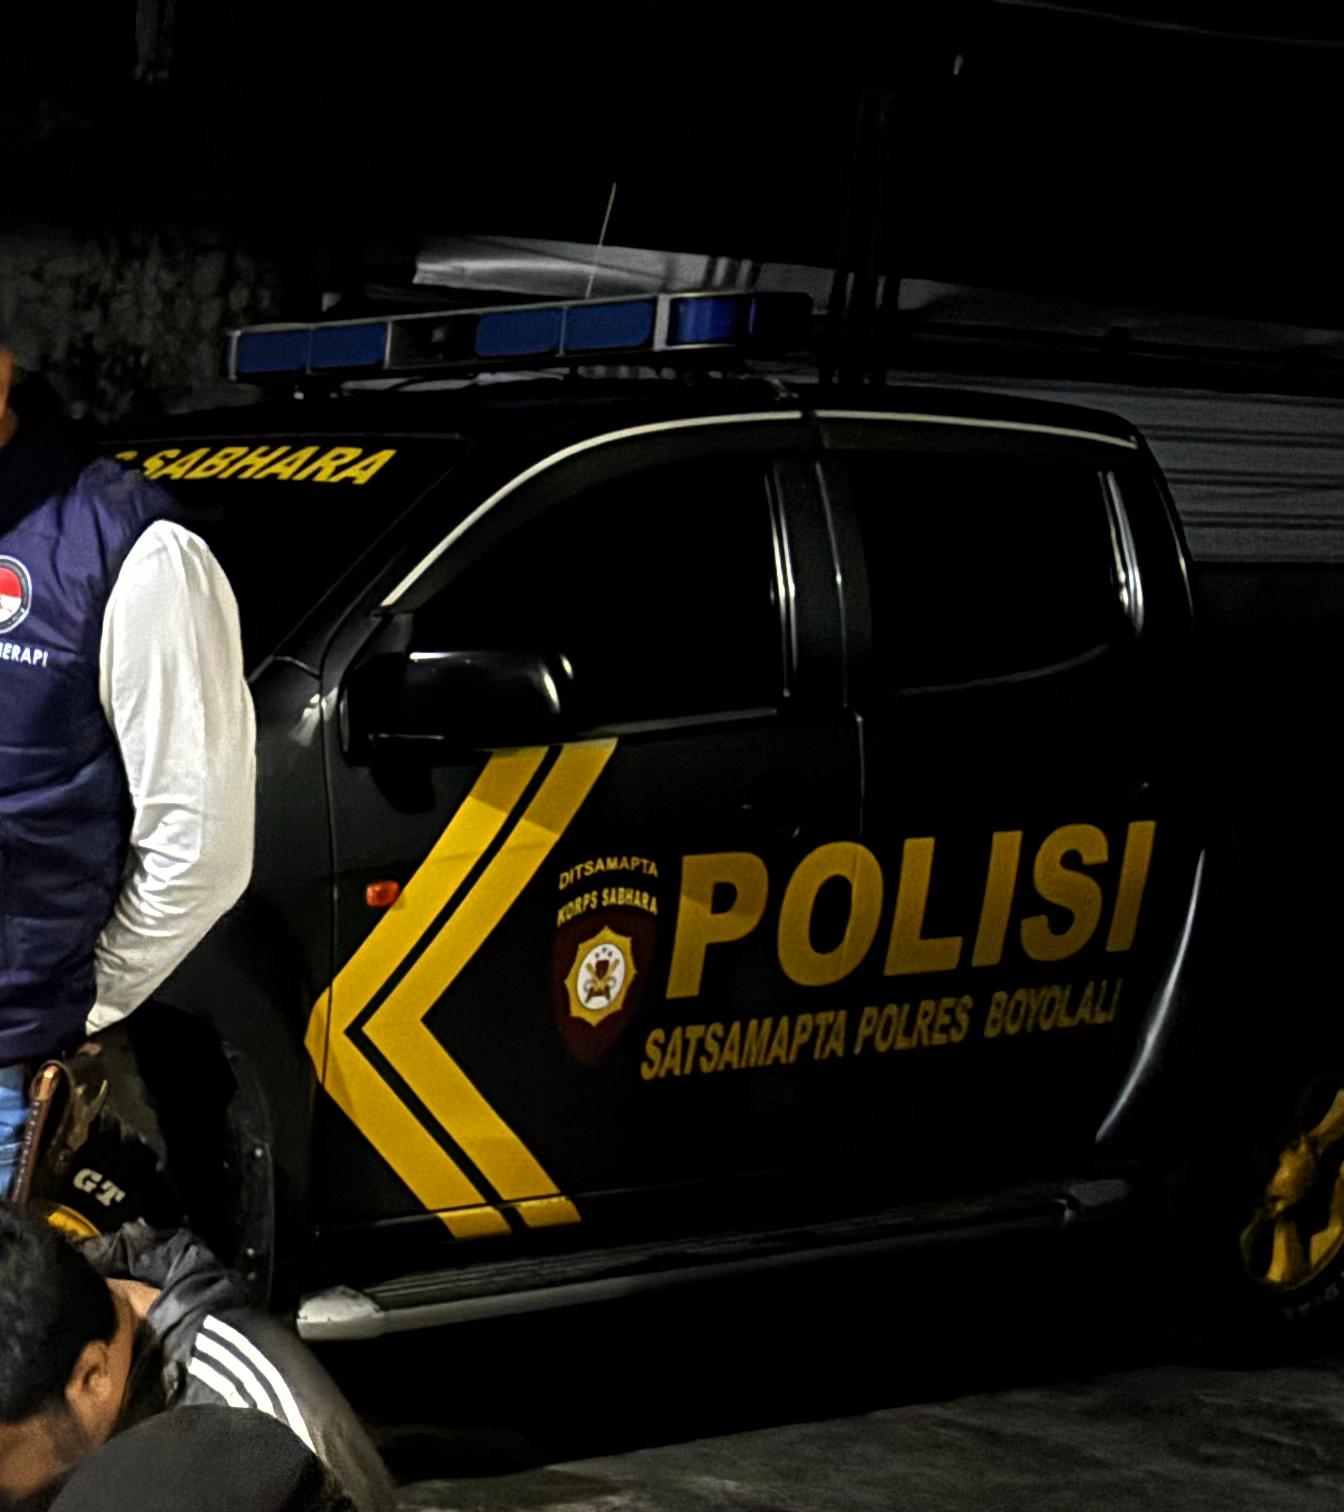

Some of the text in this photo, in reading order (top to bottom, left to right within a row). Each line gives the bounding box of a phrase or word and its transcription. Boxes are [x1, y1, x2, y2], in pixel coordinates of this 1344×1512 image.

[143, 446, 397, 484] SABHARA
[558, 856, 659, 890] DITSAMAPTA
[556, 886, 658, 927] KORPS SABHARA
[665, 820, 1157, 1000] POLISI
[639, 977, 1124, 1082] SATSAMAPTA POLRES BOYOLALI
